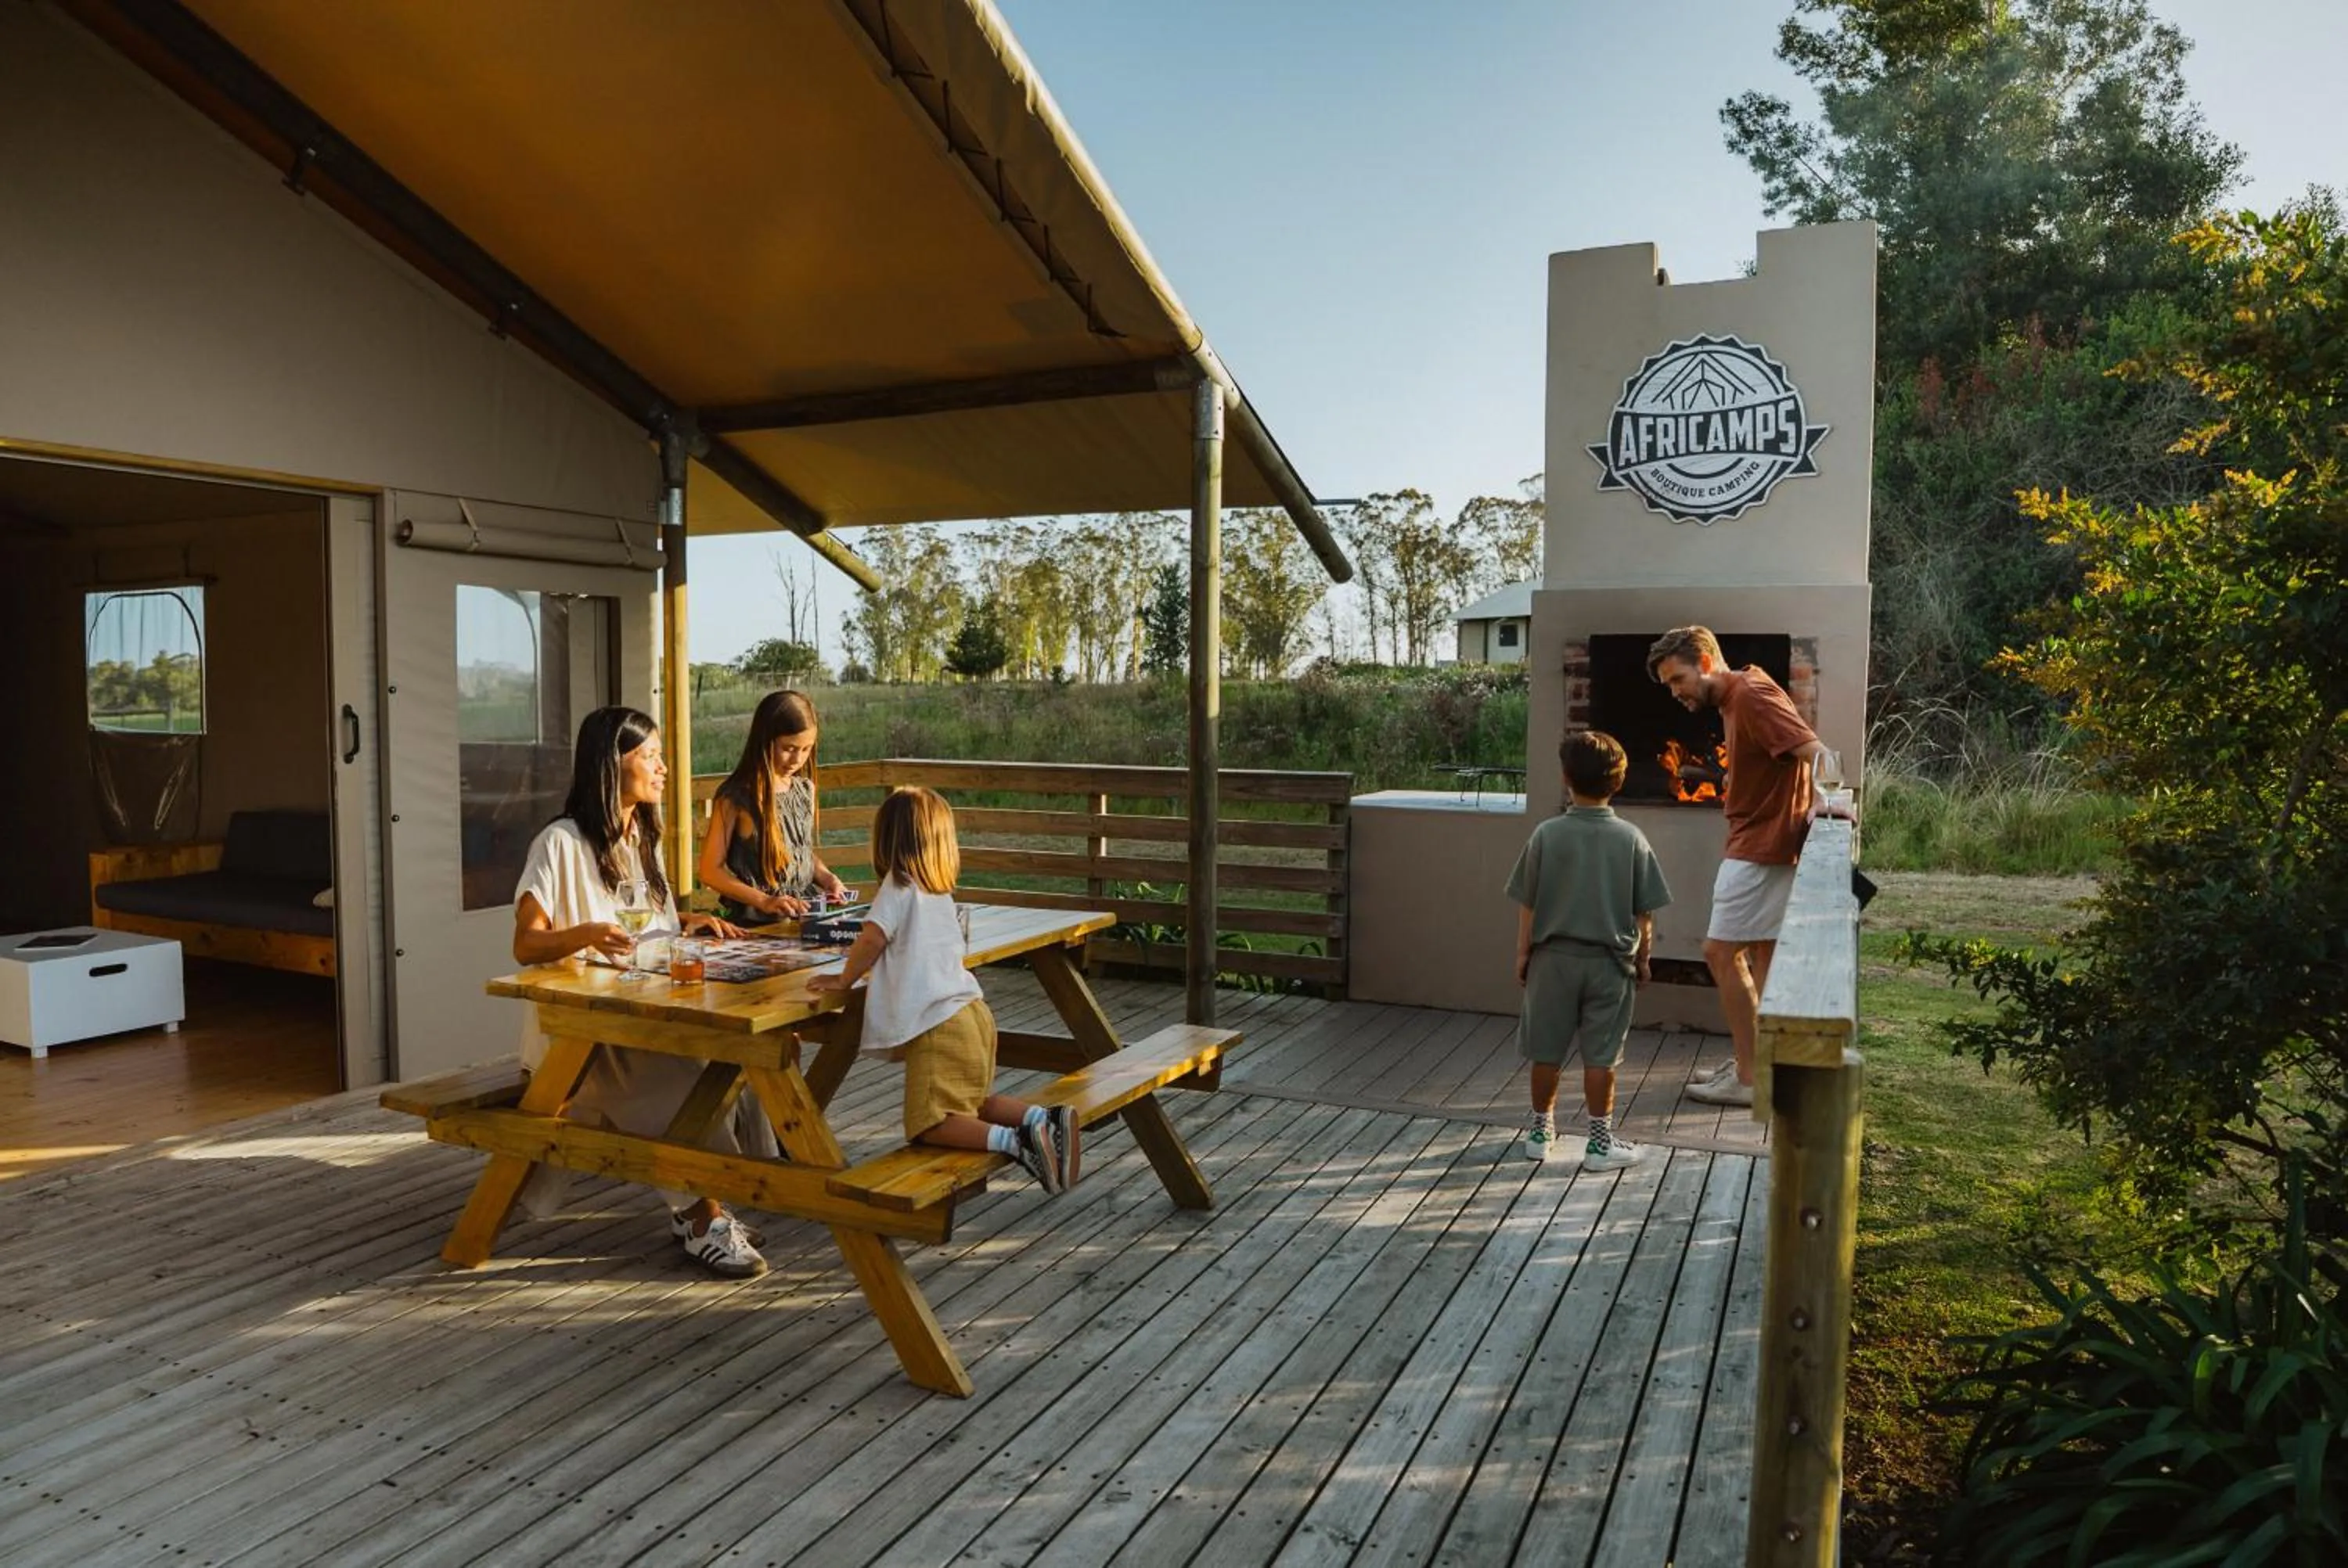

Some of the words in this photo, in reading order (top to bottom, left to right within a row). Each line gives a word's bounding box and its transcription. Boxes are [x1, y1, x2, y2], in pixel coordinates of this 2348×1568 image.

[1618, 397, 1797, 466] AFRICAMPS
[1651, 468, 1705, 498] BOUTIQUE
[1709, 461, 1760, 496] CAMPING
